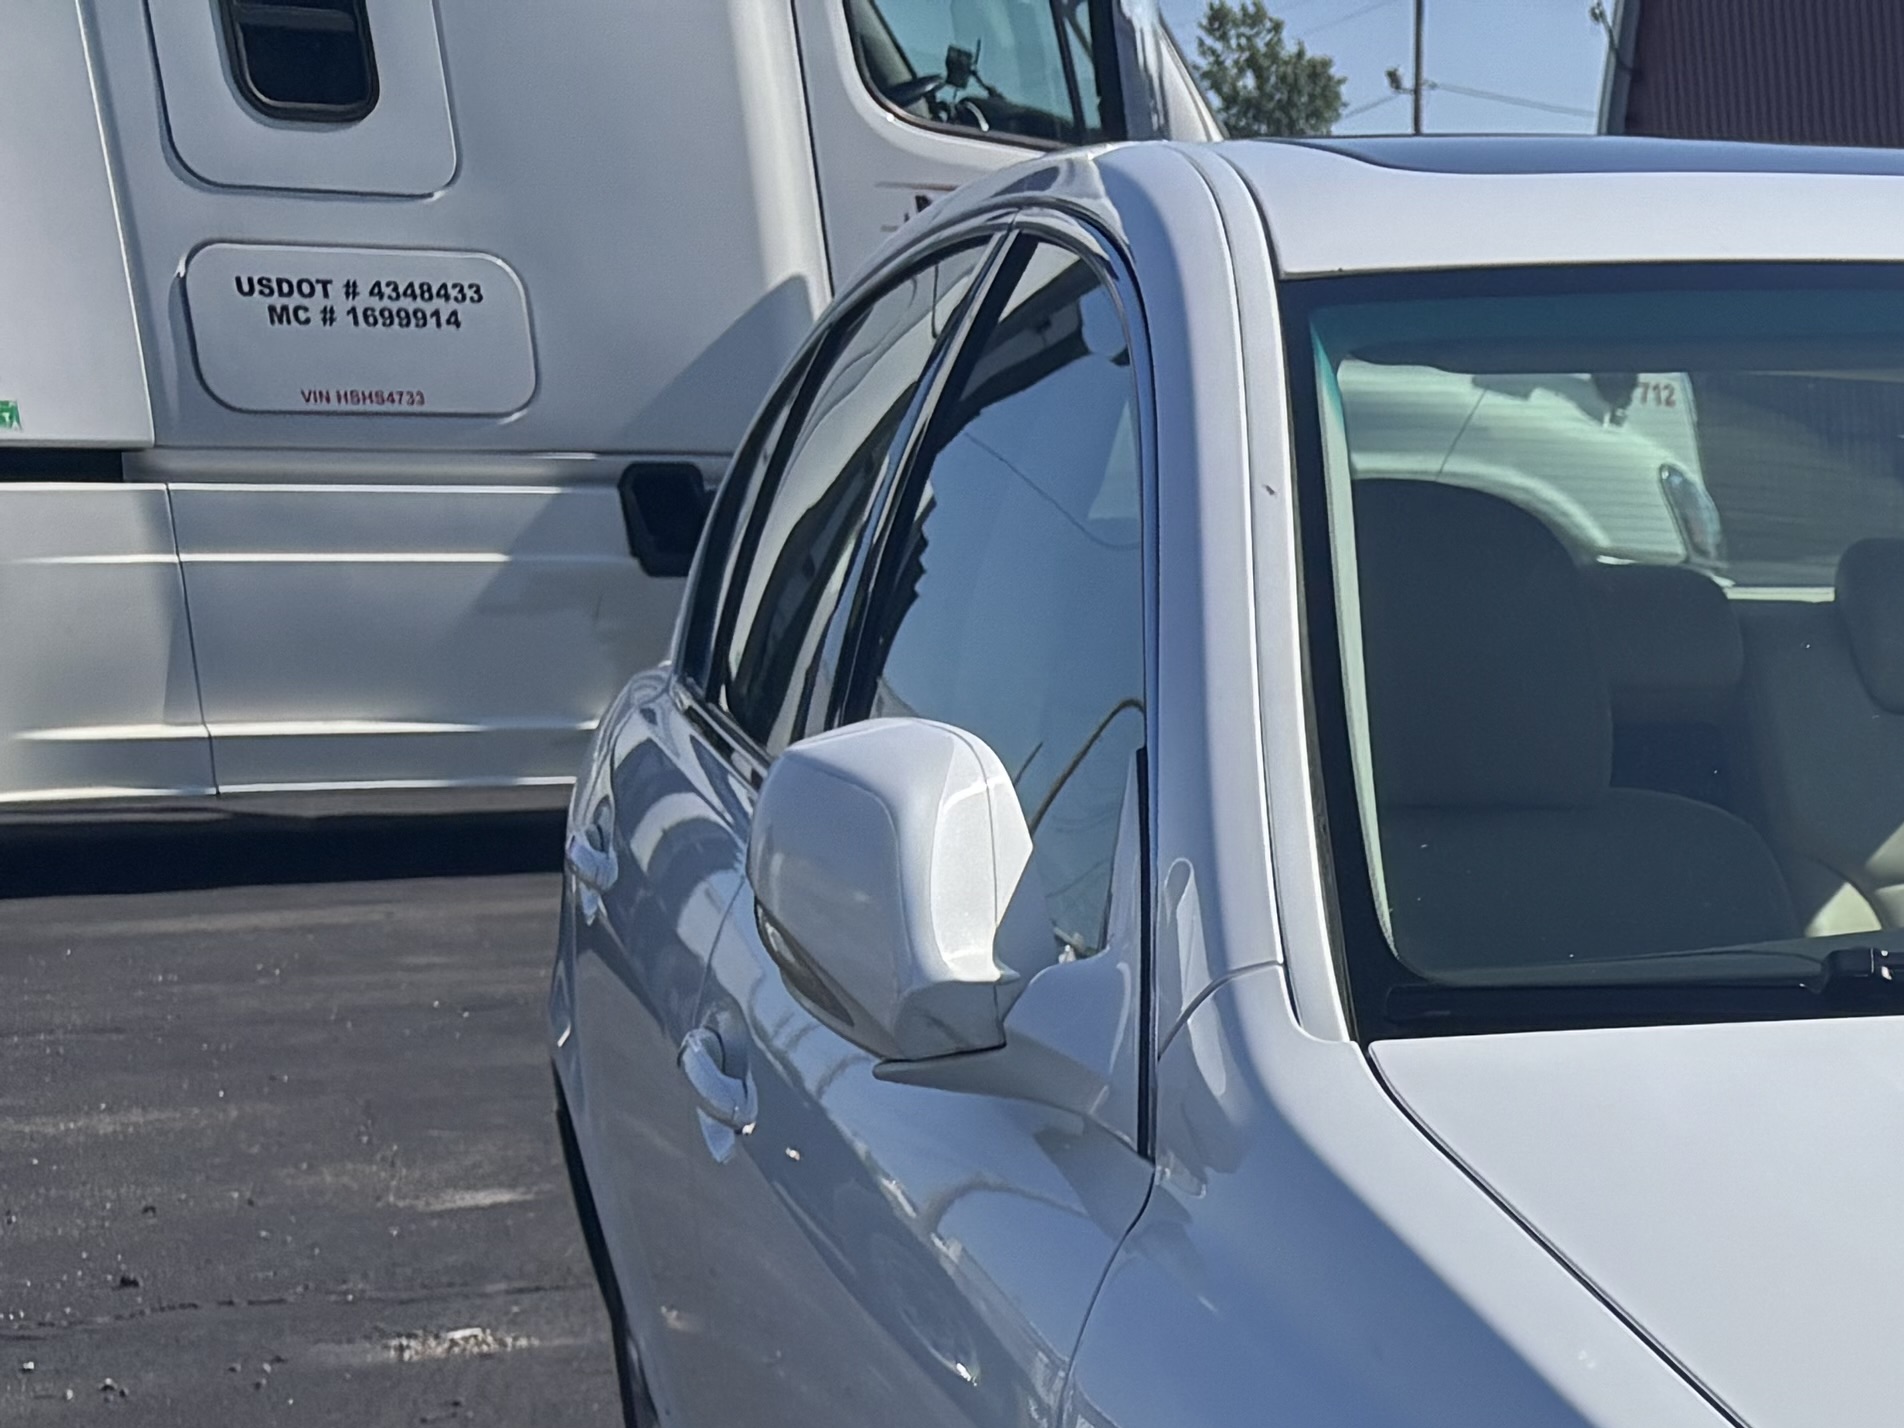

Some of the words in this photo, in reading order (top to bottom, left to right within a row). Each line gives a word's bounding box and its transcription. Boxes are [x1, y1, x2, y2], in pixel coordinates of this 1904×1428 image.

[234, 275, 333, 300] USDOT
[343, 278, 360, 301] #
[368, 280, 484, 304] 4348433
[267, 304, 311, 327] MC
[320, 304, 337, 327] #
[346, 306, 462, 330] 1699914
[300, 389, 331, 405] VIN
[1638, 381, 1677, 408] 712
